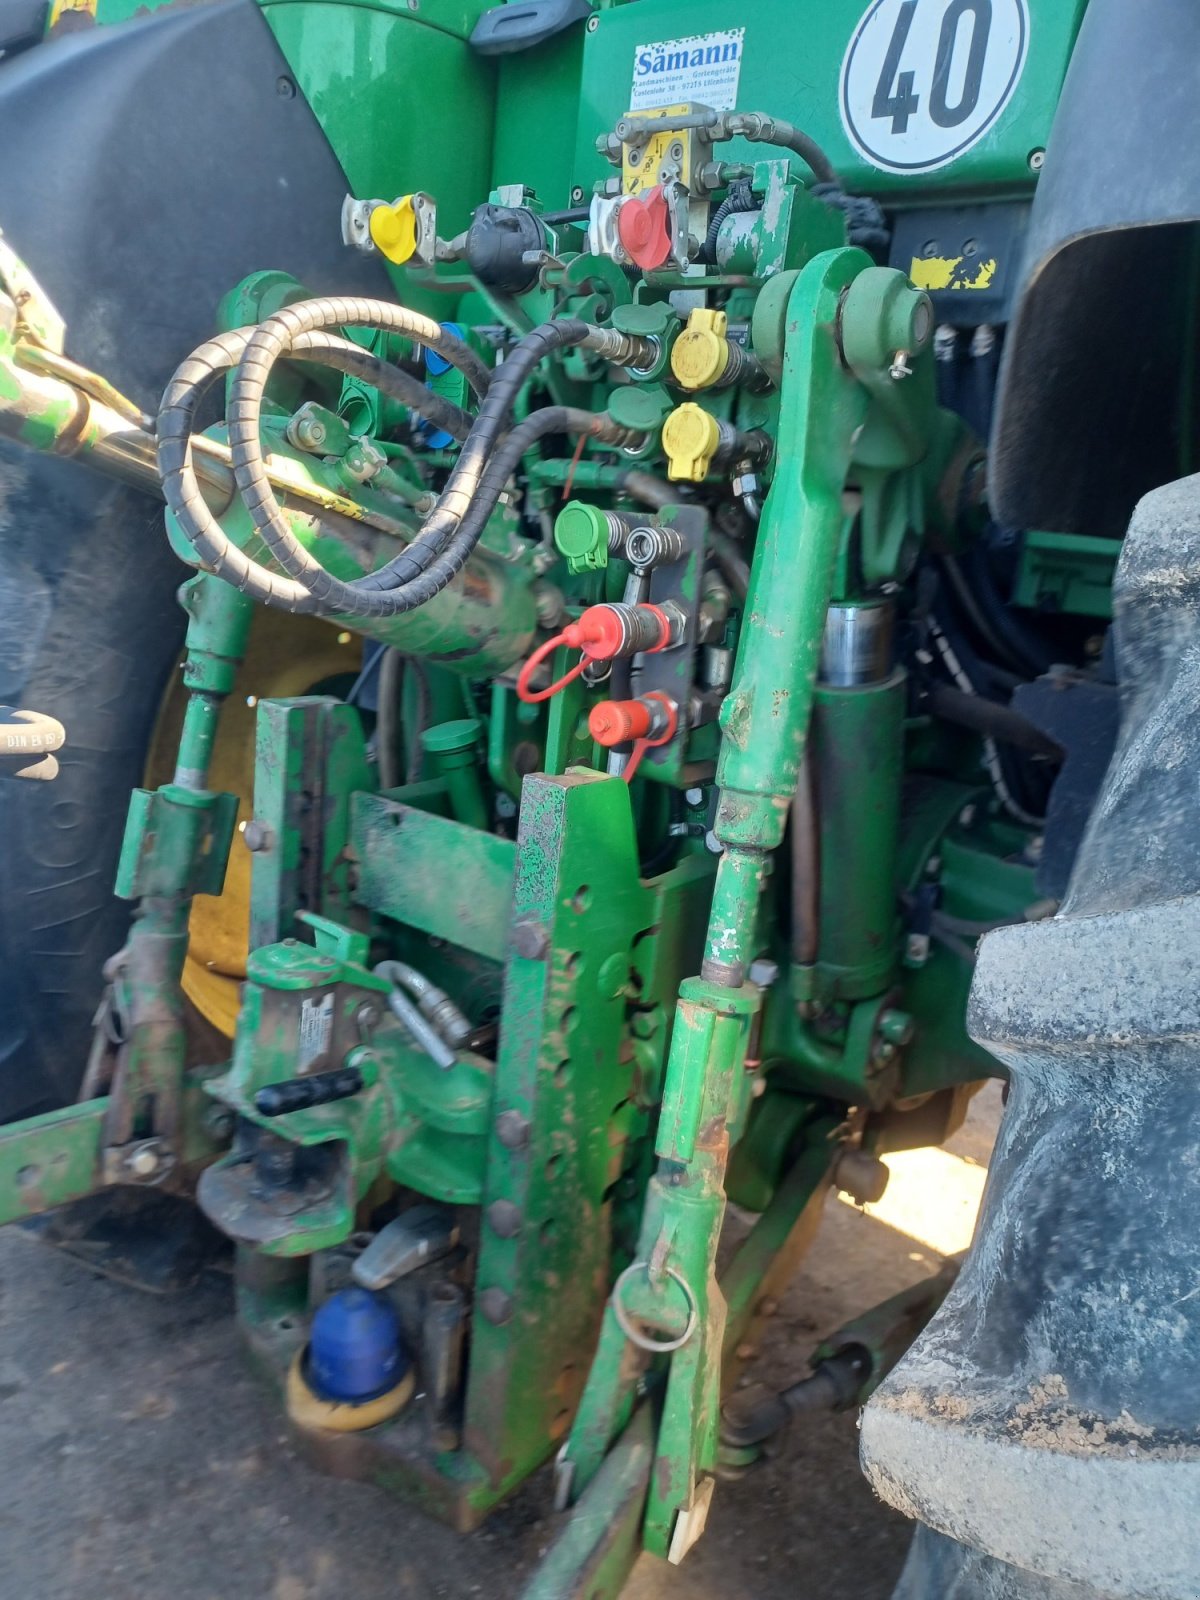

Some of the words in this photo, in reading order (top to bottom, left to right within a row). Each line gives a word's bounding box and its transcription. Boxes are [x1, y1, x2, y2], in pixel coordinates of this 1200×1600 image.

[637, 42, 738, 75] Sämann
[871, 0, 992, 134] 40
[635, 74, 683, 87] Landmaschinen
[667, 84, 675, 92] 38
[682, 81, 702, 90] 97215
[8, 735, 27, 747] DIN
